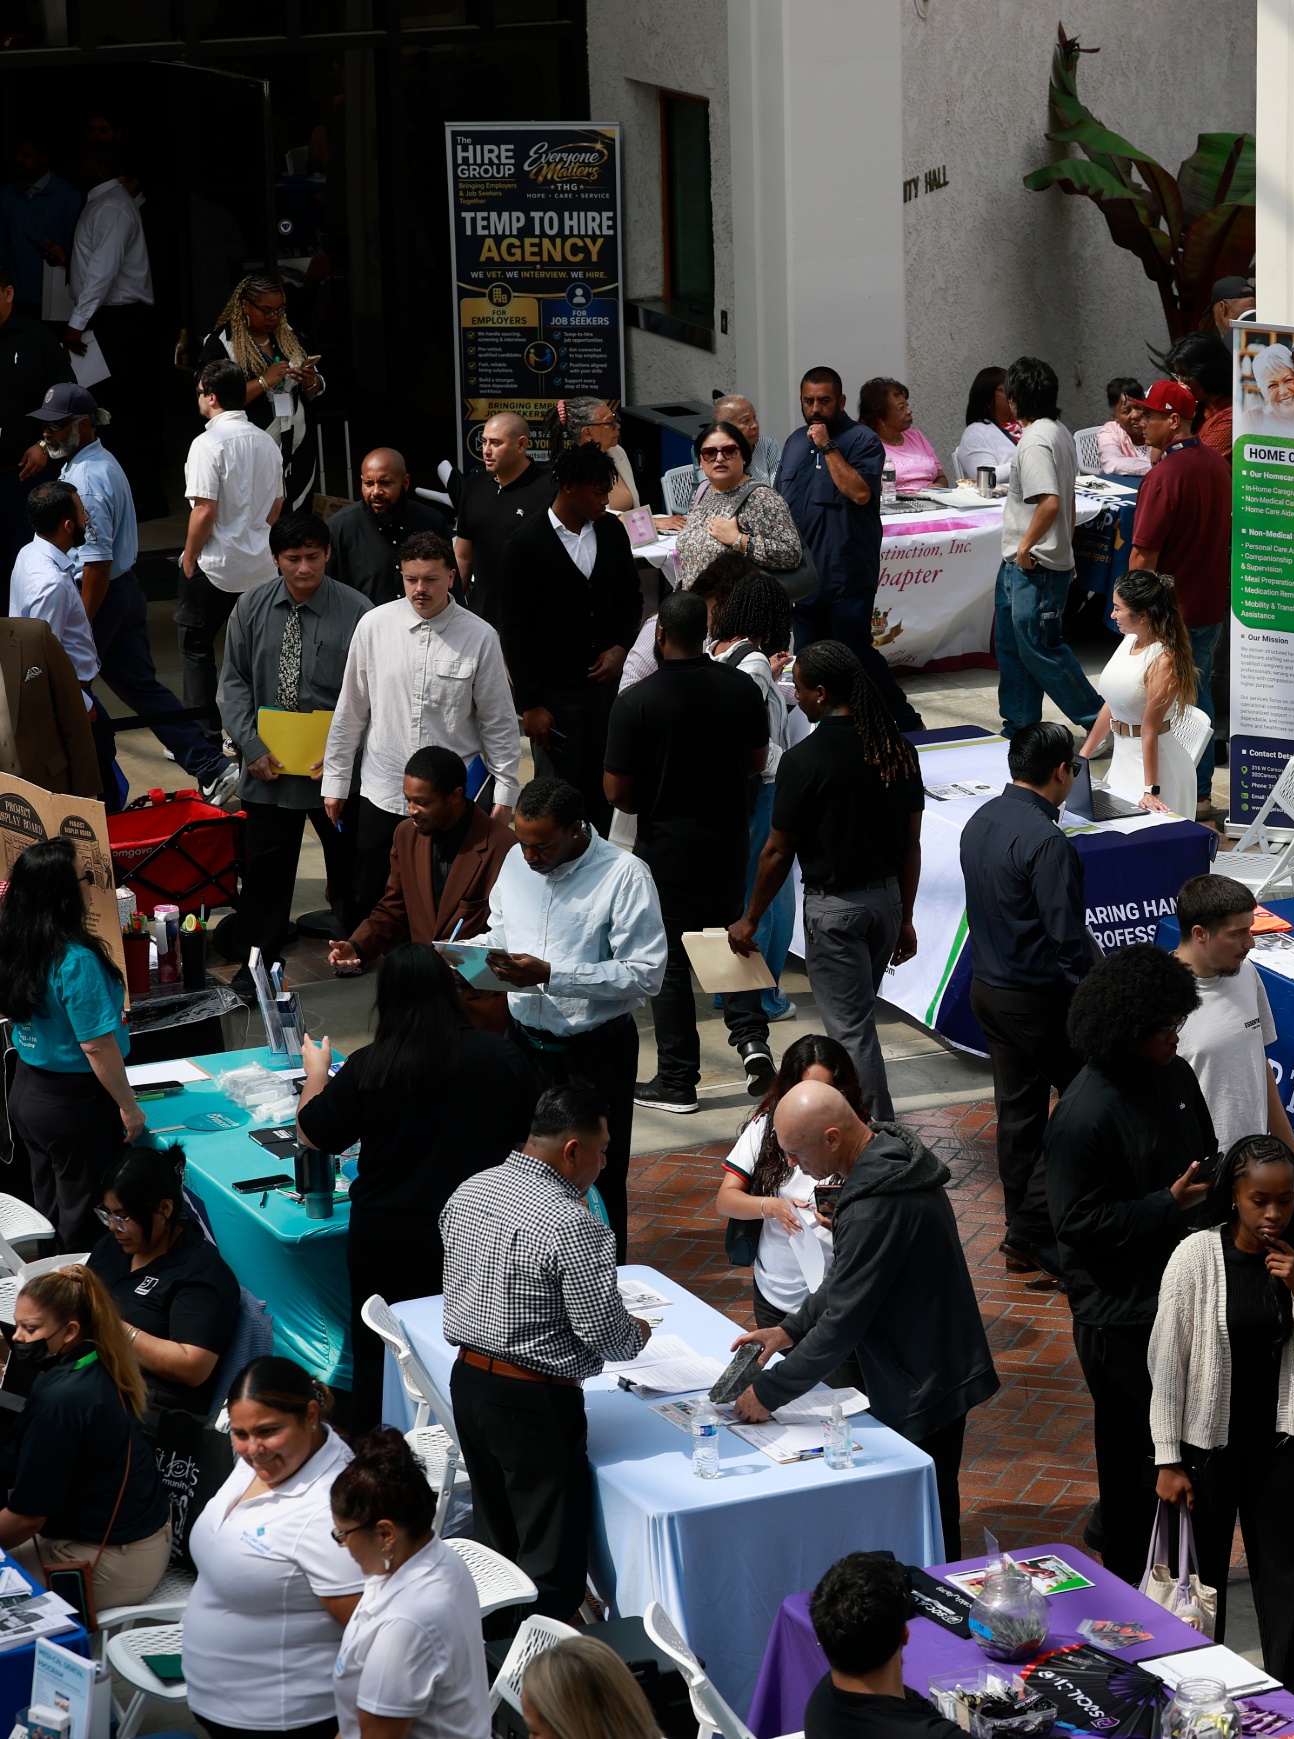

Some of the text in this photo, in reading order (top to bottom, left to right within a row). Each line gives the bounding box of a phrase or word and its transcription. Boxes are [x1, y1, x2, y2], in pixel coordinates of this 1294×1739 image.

[456, 136, 472, 144] The
[456, 144, 515, 164] HIRE
[523, 142, 600, 171] Everyone
[457, 165, 515, 178] GROUP
[529, 162, 601, 184] Matters
[458, 182, 517, 191] Bringing Employers
[556, 183, 578, 191] THG
[903, 165, 949, 204] ITY HALL
[461, 211, 614, 236] TEMP TO HIRE
[479, 237, 604, 262] AGENCY
[470, 271, 608, 279] WE VET. WE INTERVIEW. WE HIRE.
[471, 316, 527, 325] EMPLOYERS
[550, 316, 610, 325] JOB SEEKERS
[1249, 447, 1286, 461] HOME
[1249, 470, 1262, 478] Our
[1245, 484, 1272, 493] In-Home
[1245, 495, 1284, 505] Non-Medical
[1245, 505, 1294, 518] Home Care Aide
[1248, 528, 1293, 540] Non-Medical
[880, 539, 972, 562] stinction, Inc.
[1244, 542, 1272, 551] Personal
[1273, 545, 1288, 553] Care
[1244, 552, 1293, 565] Companionship
[1240, 562, 1283, 573] & Supervision
[878, 567, 943, 592] hapter
[1244, 575, 1260, 583] Meal
[1244, 586, 1279, 596] Medication
[1244, 600, 1270, 610] Mobility
[1270, 602, 1276, 610] &
[1240, 610, 1276, 620] Assistance
[1262, 635, 1289, 645] Mission
[1249, 749, 1293, 760] Contact Deta
[4, 800, 31, 819] PROJECT
[0, 812, 43, 836] SPLAY BOARD
[1085, 896, 1179, 926] ARING HAN
[1093, 924, 1157, 949] ROFESS
[162, 1478, 190, 1492] munity
